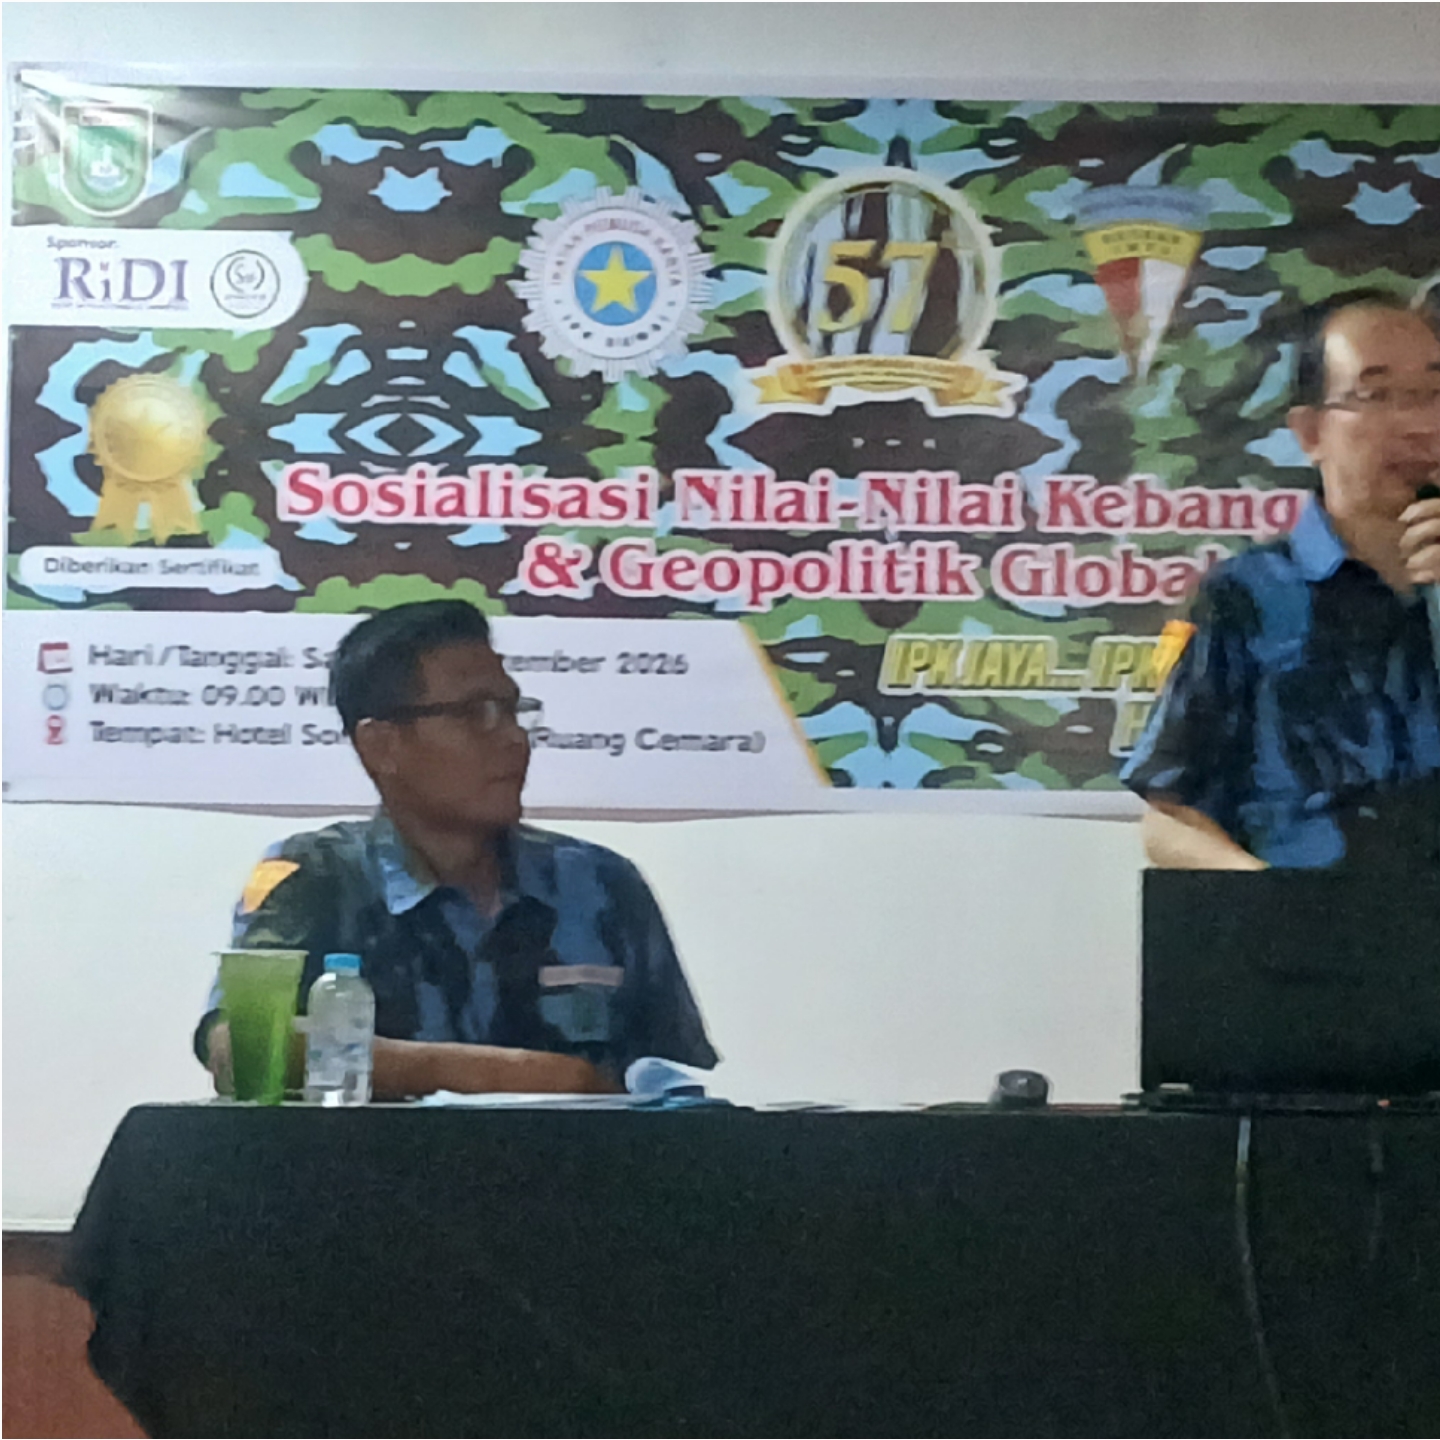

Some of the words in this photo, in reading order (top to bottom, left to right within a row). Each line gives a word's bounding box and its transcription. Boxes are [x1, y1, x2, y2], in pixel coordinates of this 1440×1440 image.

[53, 255, 189, 301] RiDI
[819, 239, 944, 334] 57
[285, 466, 652, 521] Sosialisasi
[681, 469, 1020, 527] Nilai-Nilai
[1044, 477, 1299, 536] Kebang
[43, 556, 153, 574] Diberikan
[159, 557, 262, 576] Sertifikat
[526, 541, 582, 590] &
[608, 543, 978, 608] Geopolitik
[200, 683, 287, 706] 09.00
[212, 721, 293, 746] Hotel
[634, 727, 767, 755] Cemara)
